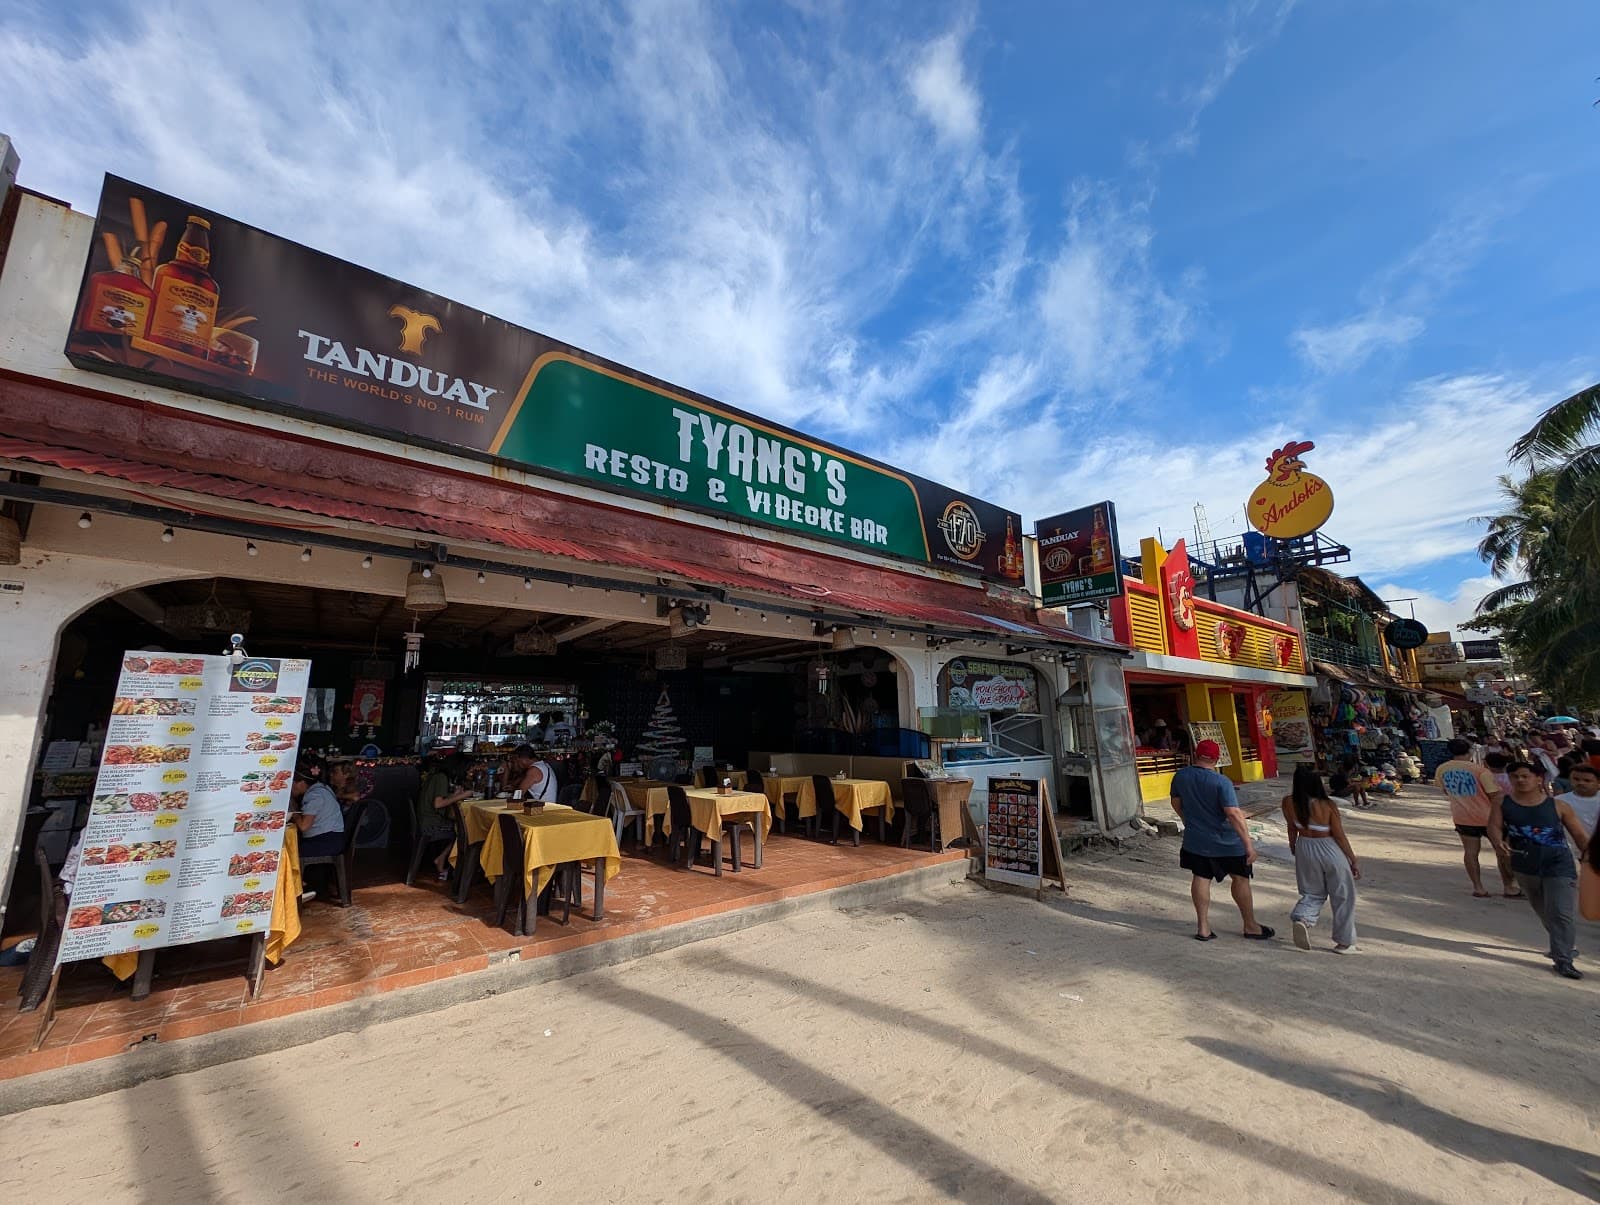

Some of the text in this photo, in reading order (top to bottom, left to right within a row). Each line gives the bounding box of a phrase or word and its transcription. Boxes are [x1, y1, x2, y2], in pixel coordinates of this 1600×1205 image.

[298, 329, 497, 410] TANDUAY
[307, 367, 485, 424] THE WORLD'S NO. 1 RUM
[672, 407, 847, 507] TYANG'S
[584, 443, 887, 545] RESTO & VIDEOKE BAR
[1260, 479, 1323, 532] Andok's
[1040, 531, 1079, 547] TANDUAY
[1062, 577, 1093, 595] TYANG'S
